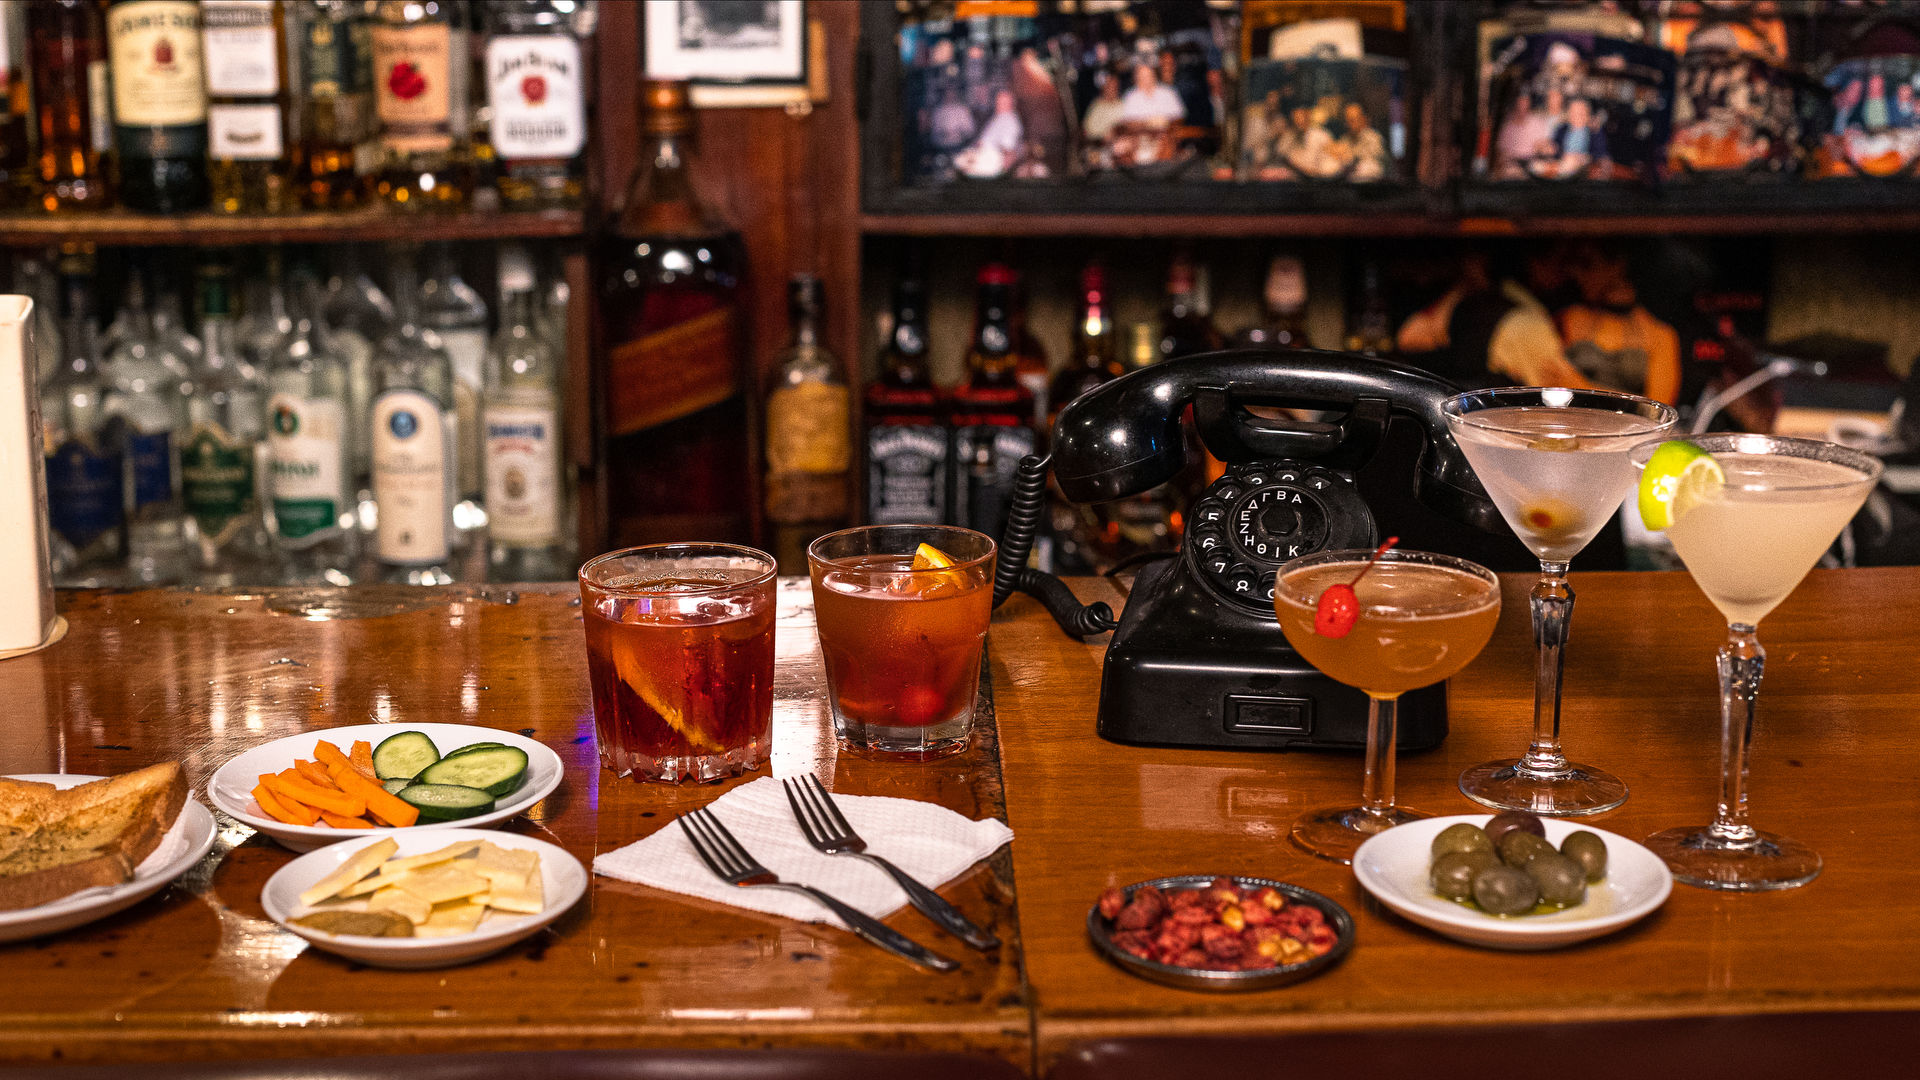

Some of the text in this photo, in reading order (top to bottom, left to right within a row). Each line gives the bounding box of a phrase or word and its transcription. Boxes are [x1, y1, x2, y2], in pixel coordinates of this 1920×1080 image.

[1315, 481, 1323, 490] 1
[1262, 492, 1271, 502] Γ
[1248, 499, 1259, 509] Δ
[1257, 543, 1267, 554] Θ
[1215, 562, 1226, 573] 7
[1235, 580, 1248, 591] 8
